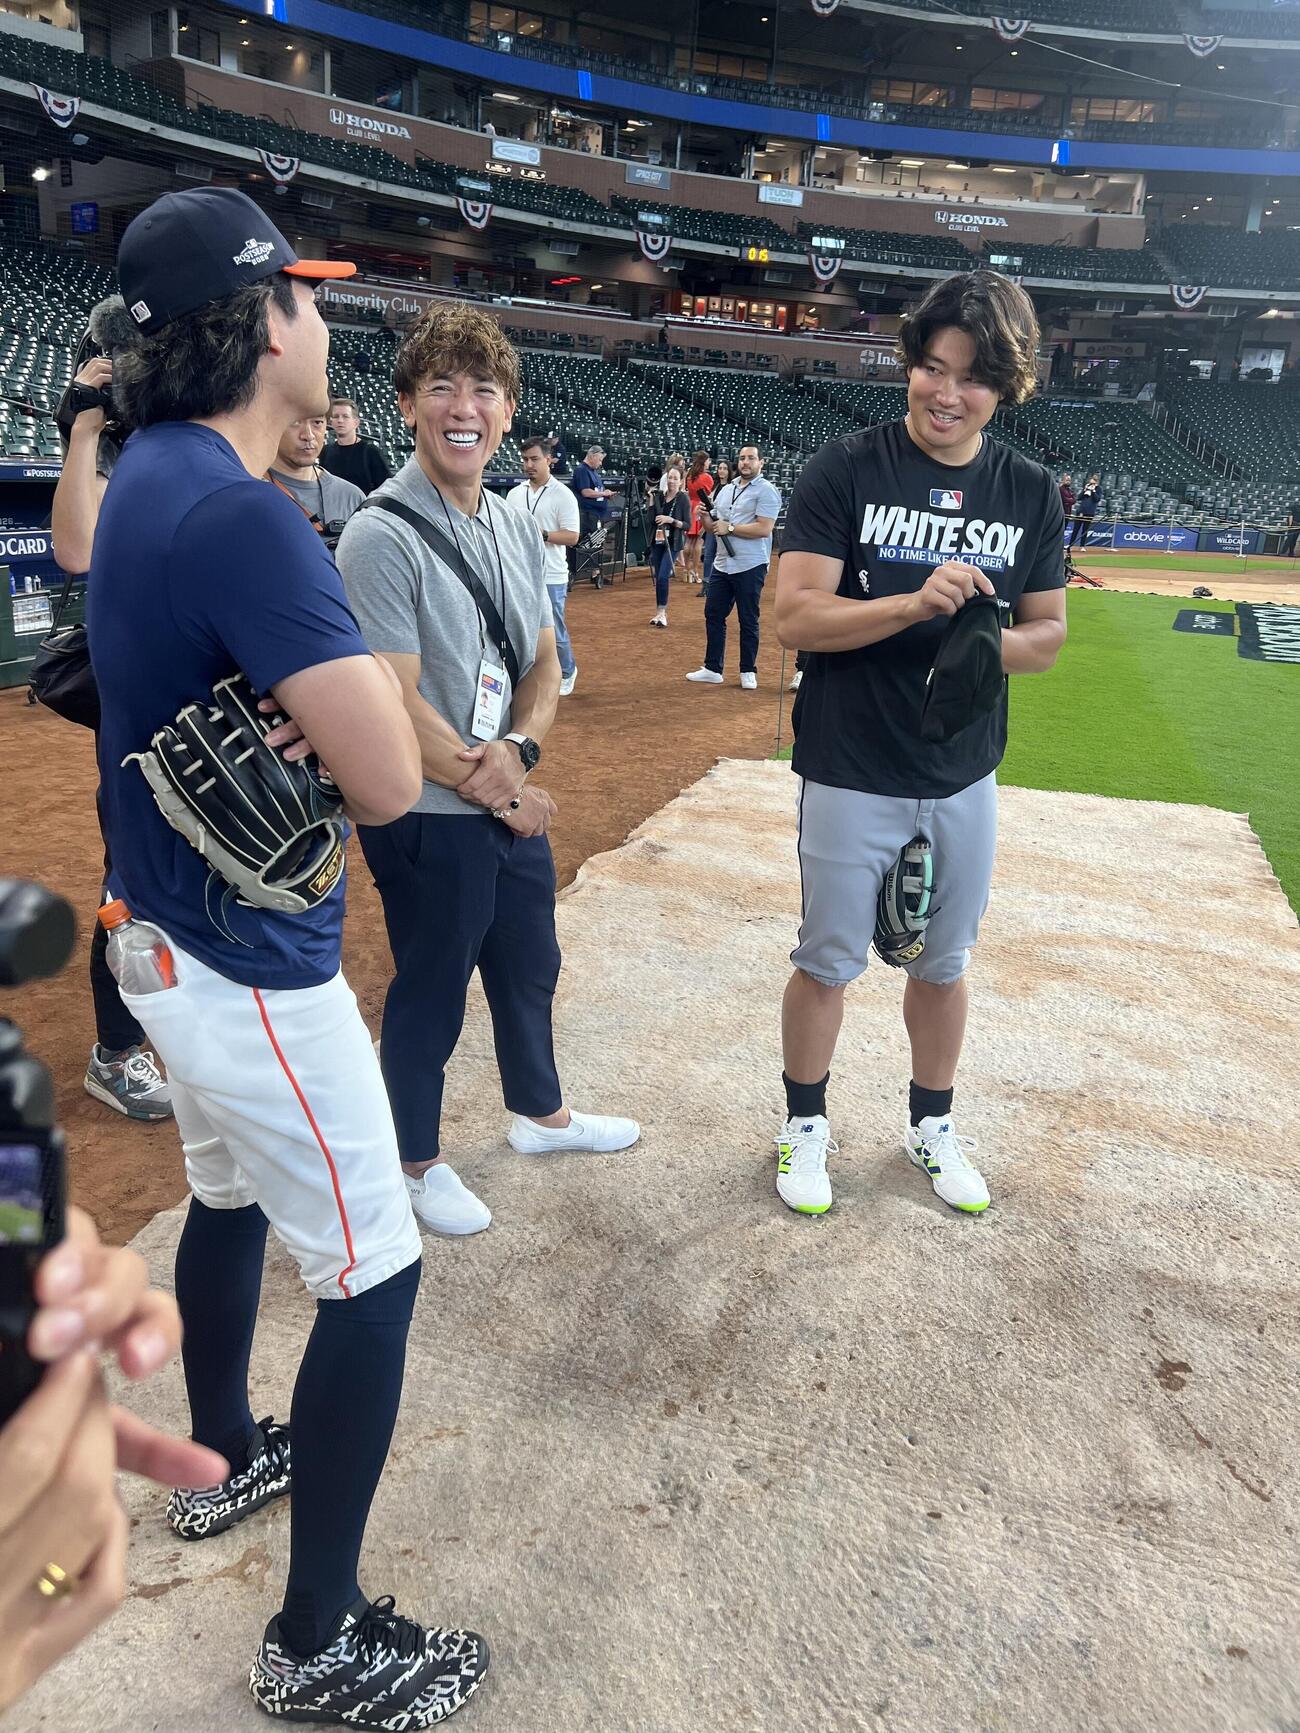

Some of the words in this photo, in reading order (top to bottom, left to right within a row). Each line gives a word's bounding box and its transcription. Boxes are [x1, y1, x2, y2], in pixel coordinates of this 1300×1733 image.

[346, 113, 412, 139] HONDA
[347, 127, 363, 138] CLUB
[363, 130, 382, 142] LEVEL
[949, 213, 1009, 227] HONDA
[963, 225, 980, 233] LEVEL
[233, 241, 275, 266] POSTSEASON
[323, 286, 389, 315] Insperity
[391, 297, 422, 315] Club
[32, 468, 62, 478] POSTSEAS
[860, 504, 965, 554] WHITE
[961, 518, 1024, 567] SOX
[1123, 531, 1165, 543] abbvie
[0, 537, 47, 556] DCARD
[879, 547, 897, 559] NO
[899, 548, 926, 562] TIME
[928, 552, 949, 564] LIKE
[951, 554, 1004, 569] OCTOBER
